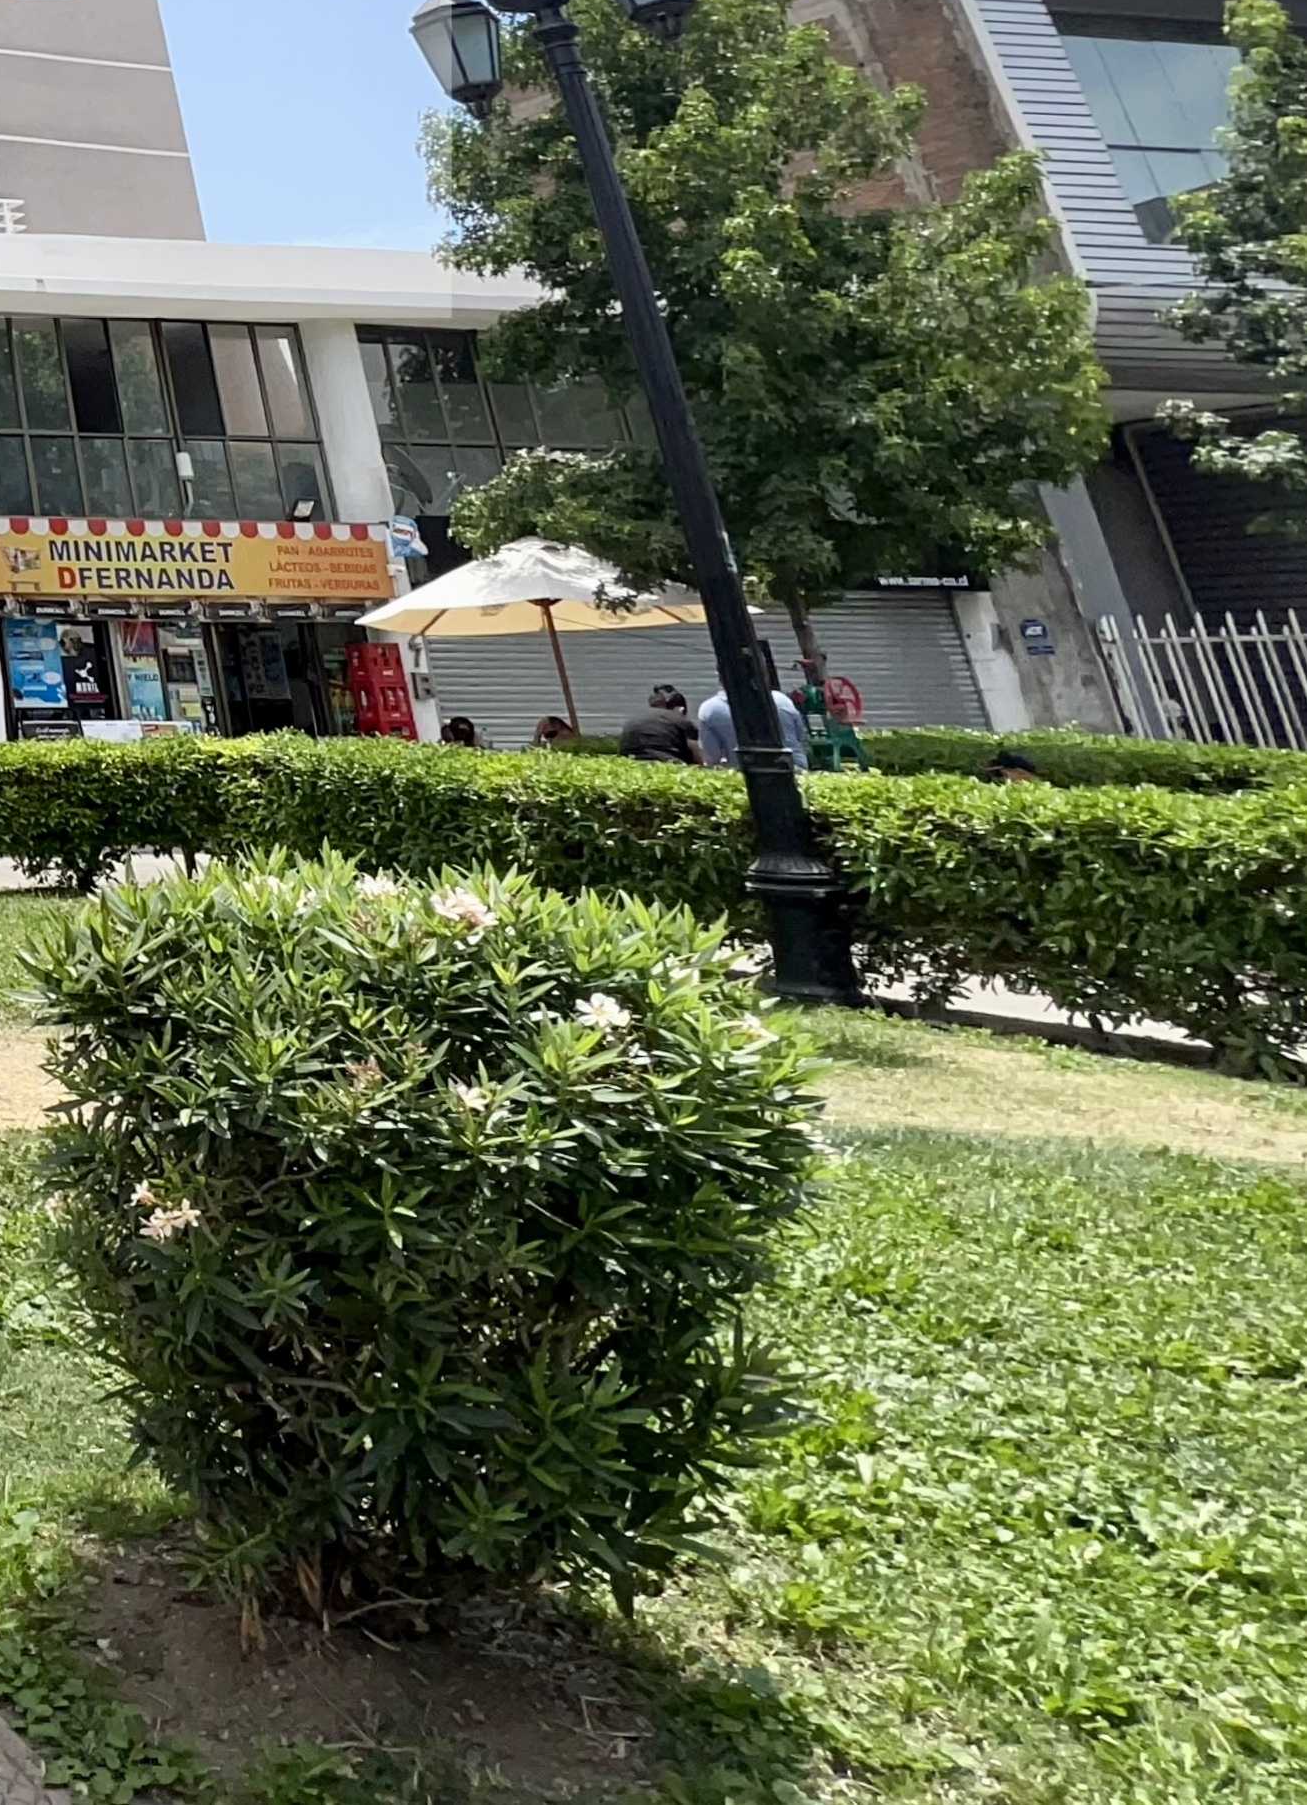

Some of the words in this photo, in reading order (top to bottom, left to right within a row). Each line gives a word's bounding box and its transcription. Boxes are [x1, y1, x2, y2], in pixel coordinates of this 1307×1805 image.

[48, 540, 233, 563] MINIMARKET
[277, 545, 299, 556] PAN
[57, 566, 235, 590] DFERNANDA
[268, 578, 311, 589] FRUTAS
